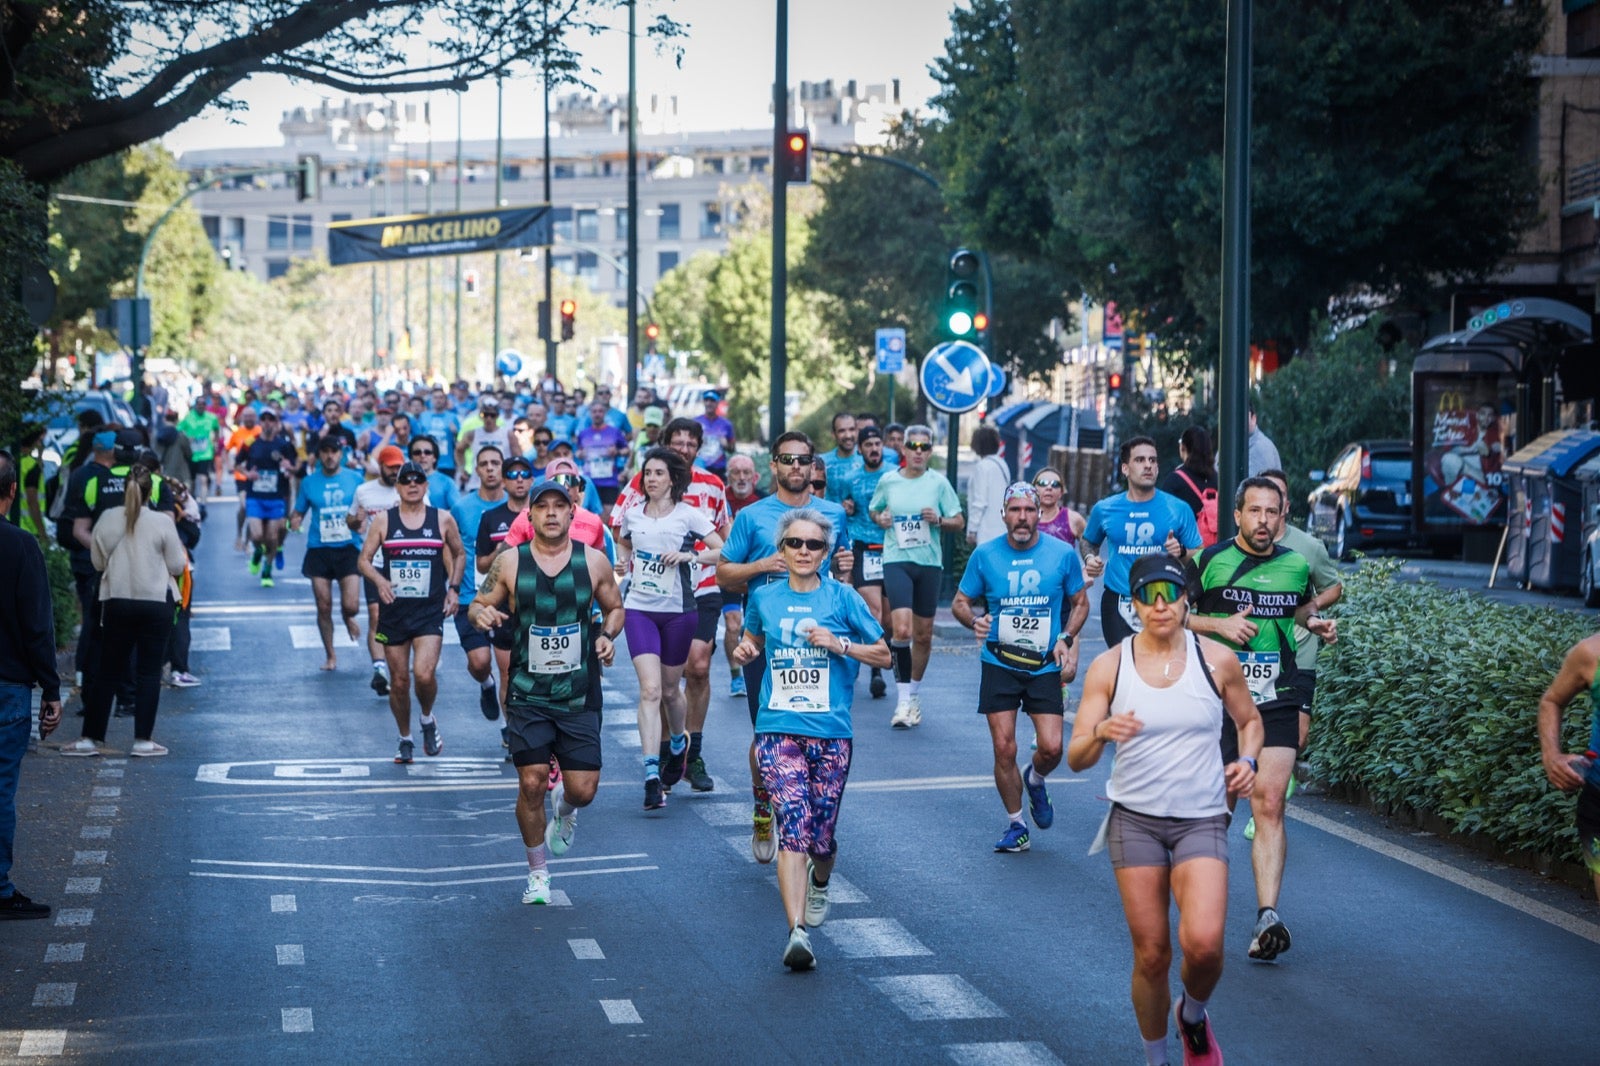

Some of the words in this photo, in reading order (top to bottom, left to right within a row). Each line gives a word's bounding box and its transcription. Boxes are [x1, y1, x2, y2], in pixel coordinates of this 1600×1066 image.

[381, 217, 500, 248] MARCELINO
[901, 522, 921, 532] 594
[1125, 522, 1155, 546] 18
[1118, 545, 1162, 555] MARCELINO
[400, 569, 421, 579] 836
[642, 561, 665, 575] 740
[1008, 569, 1041, 596] 18
[1000, 596, 1049, 606] MARCELINO
[1222, 588, 1253, 604] CAJA
[1012, 617, 1039, 630] 922
[541, 636, 569, 650] 830
[774, 647, 828, 658] MARCELINO
[780, 669, 820, 685] 1009
[1241, 664, 1272, 679] 065
